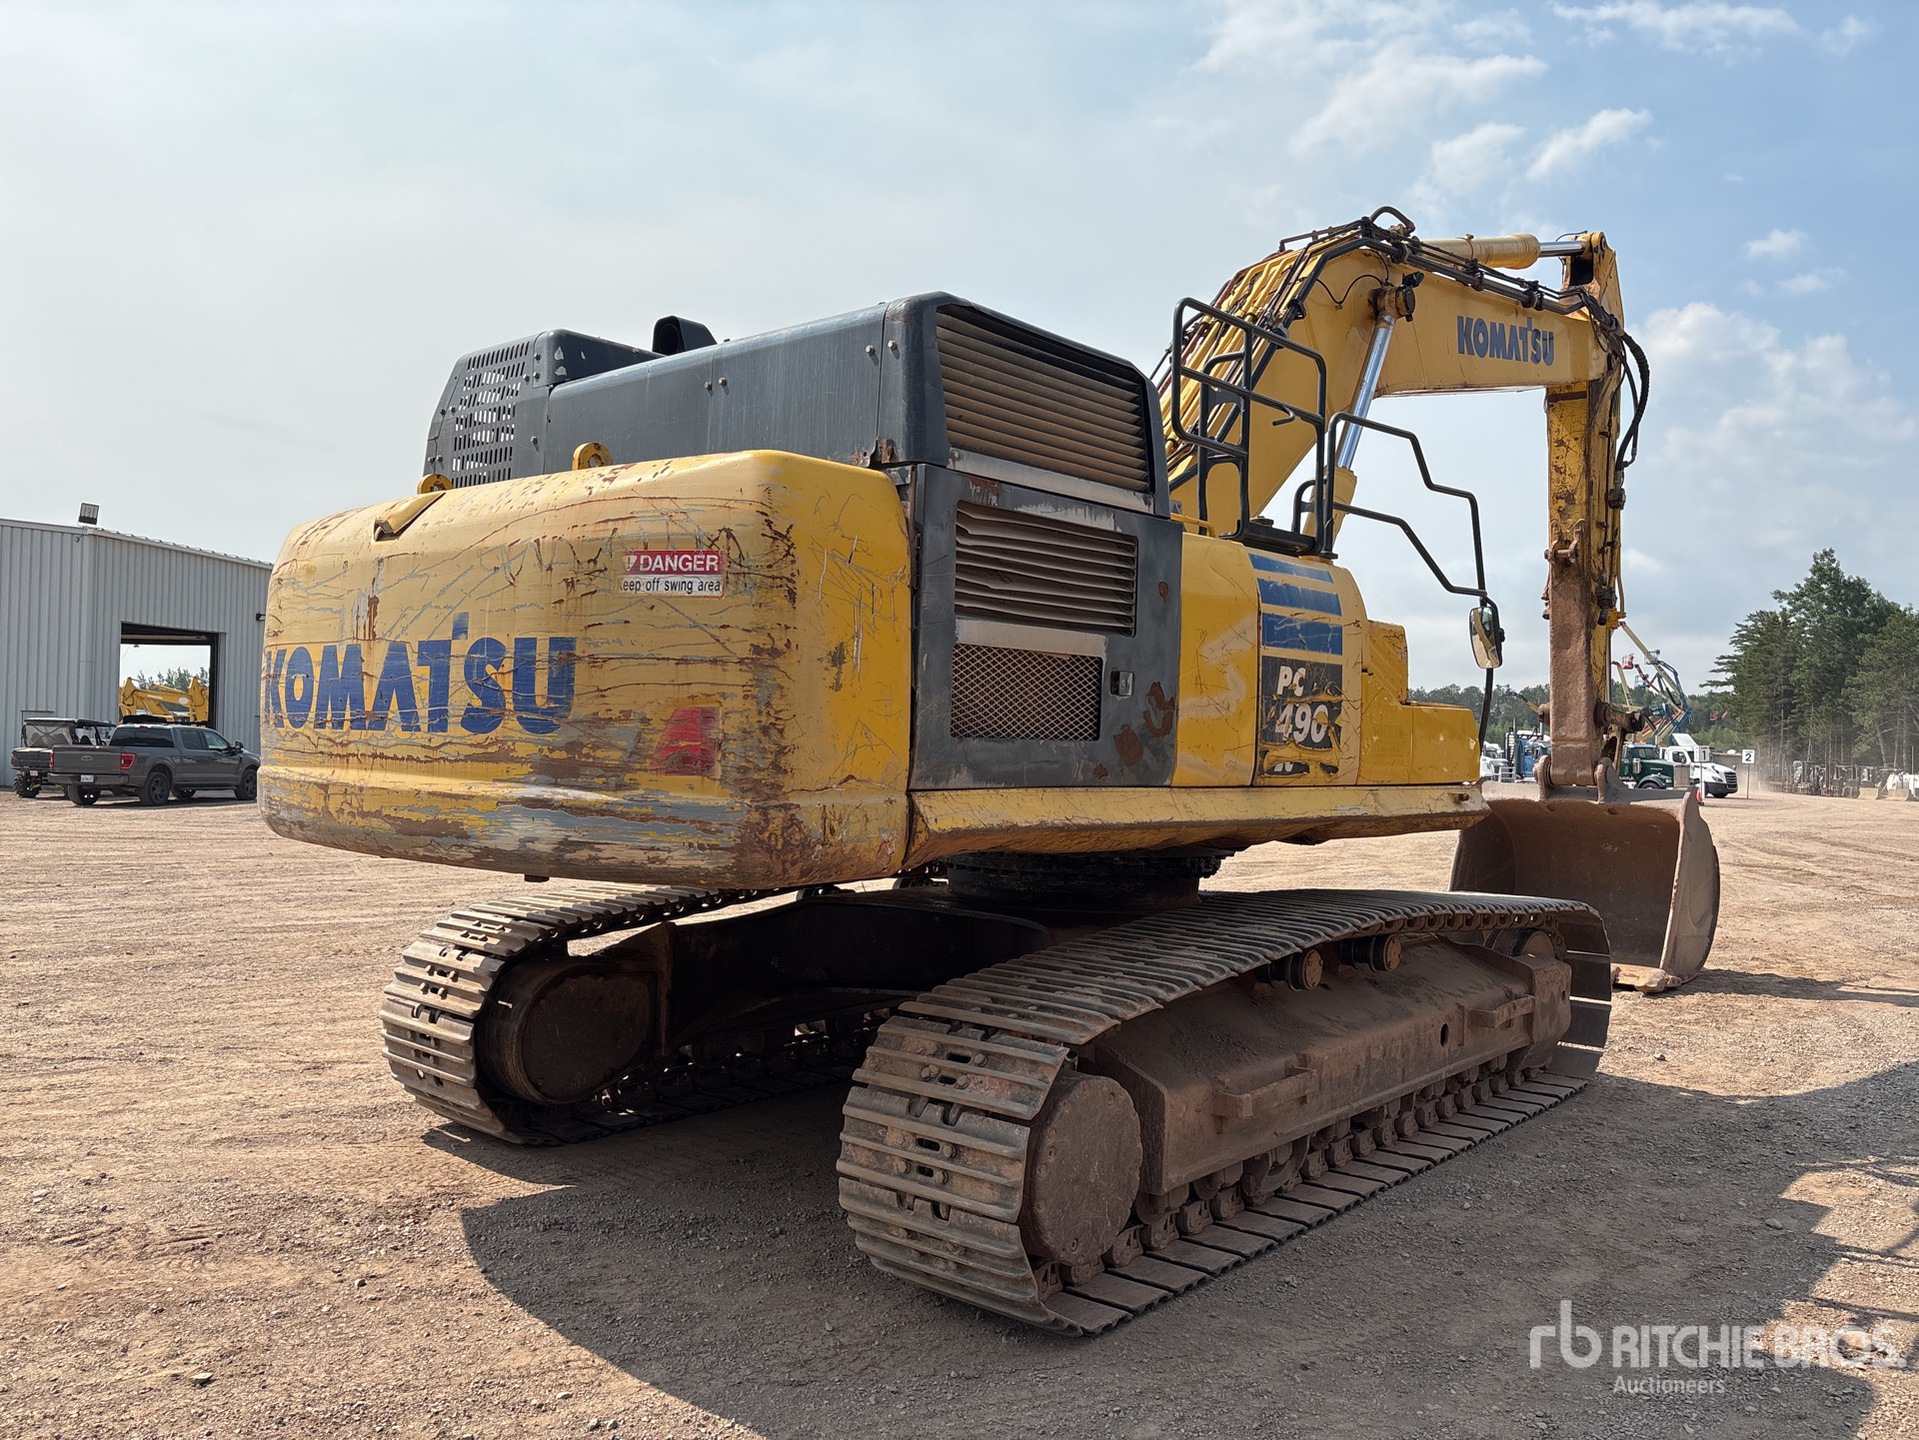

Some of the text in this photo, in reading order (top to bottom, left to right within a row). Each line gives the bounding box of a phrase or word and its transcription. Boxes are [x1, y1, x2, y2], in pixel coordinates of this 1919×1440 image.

[1456, 315, 1555, 367] KOMATSU
[640, 554, 719, 572] DANGER
[646, 577, 660, 591] off
[664, 580, 693, 594] swing
[698, 580, 720, 591] area
[265, 612, 577, 734] KOMATSU
[1276, 665, 1306, 697] PC
[1274, 702, 1329, 743] 490
[1702, 750, 1706, 761] 1
[1745, 753, 1752, 762] 2
